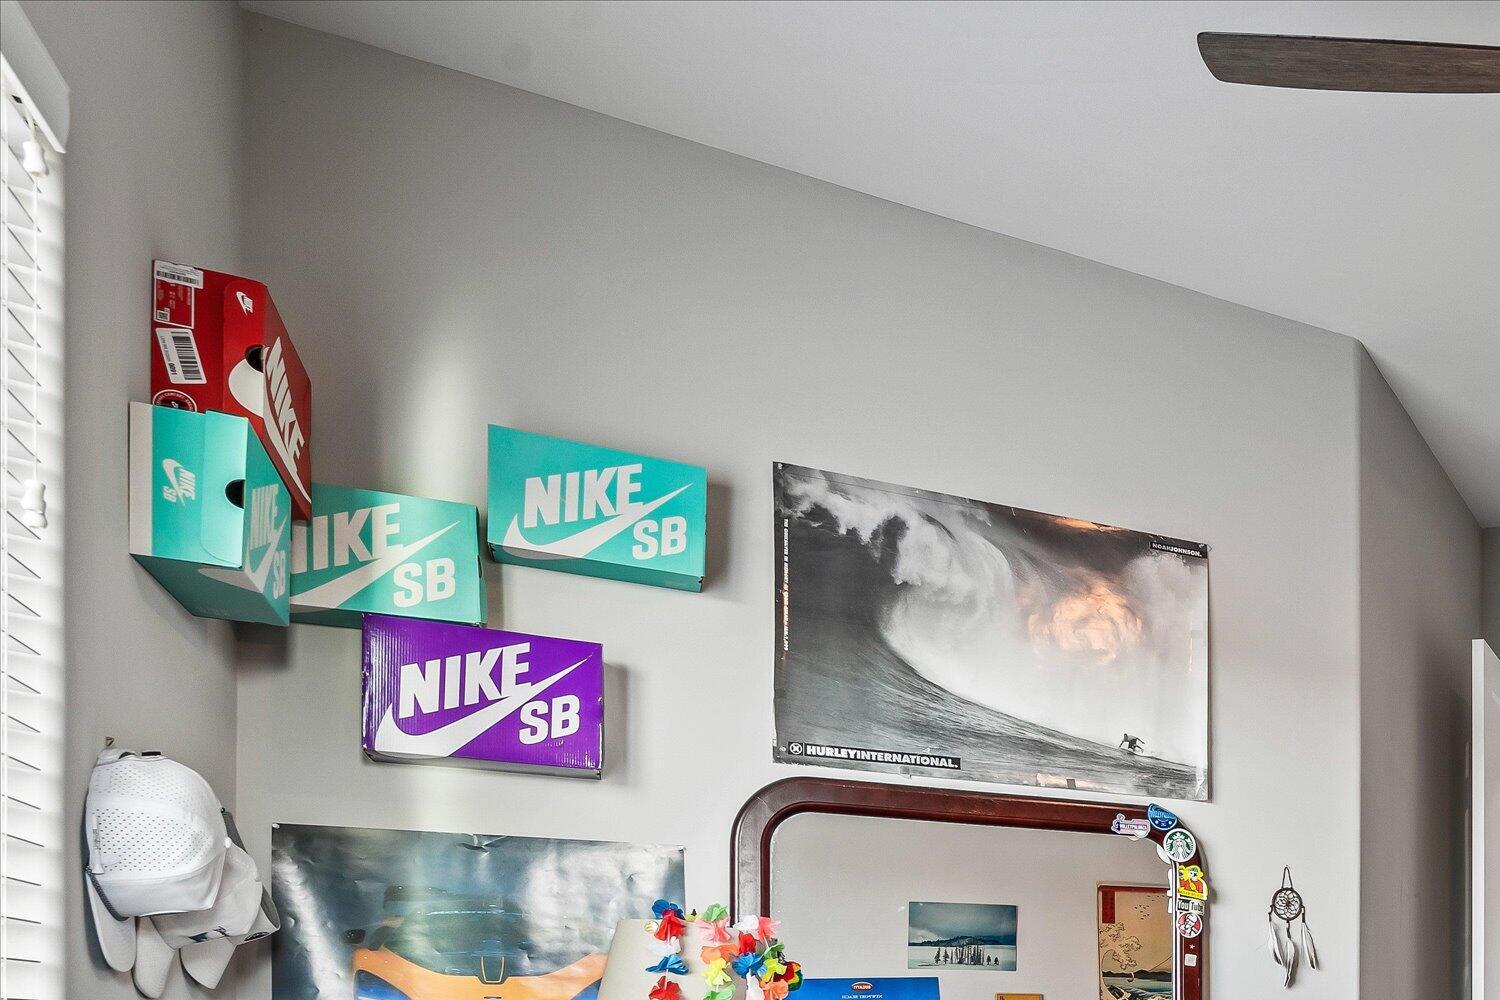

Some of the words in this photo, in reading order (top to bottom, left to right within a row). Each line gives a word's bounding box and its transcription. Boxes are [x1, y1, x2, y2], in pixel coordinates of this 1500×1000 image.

[266, 336, 305, 472] NIKE
[179, 467, 196, 500] NIKE
[524, 464, 645, 528] NIKE
[249, 484, 279, 550] NIKE
[632, 517, 687, 560] SB
[393, 558, 456, 608] SB
[399, 642, 533, 720] NIKE
[519, 695, 581, 745] SB
[806, 745, 958, 768] HURLEYINTERNATIONAL.
